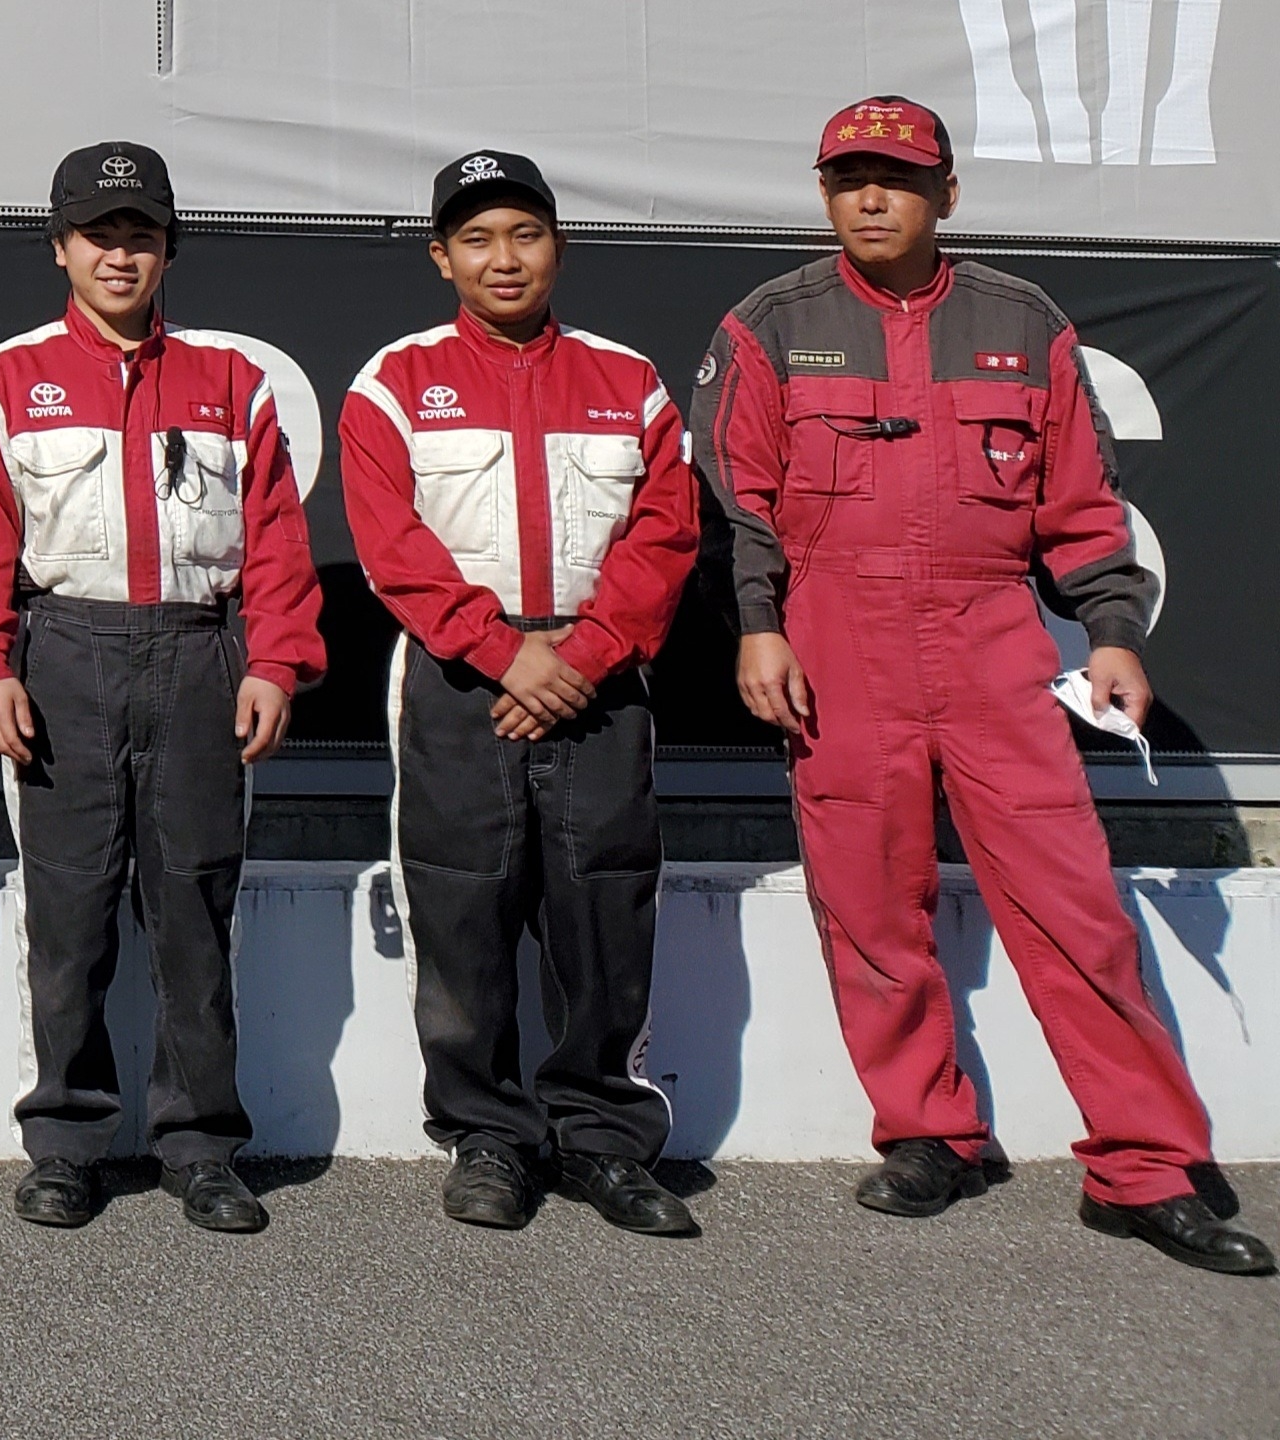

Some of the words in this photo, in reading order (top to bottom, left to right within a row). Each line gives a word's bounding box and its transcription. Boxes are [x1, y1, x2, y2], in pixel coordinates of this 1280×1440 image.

[95, 178, 143, 189] TOYOTA
[458, 170, 507, 186] TOYOTA
[26, 405, 73, 419] TOYOTA
[417, 407, 467, 421] TOYOTA
